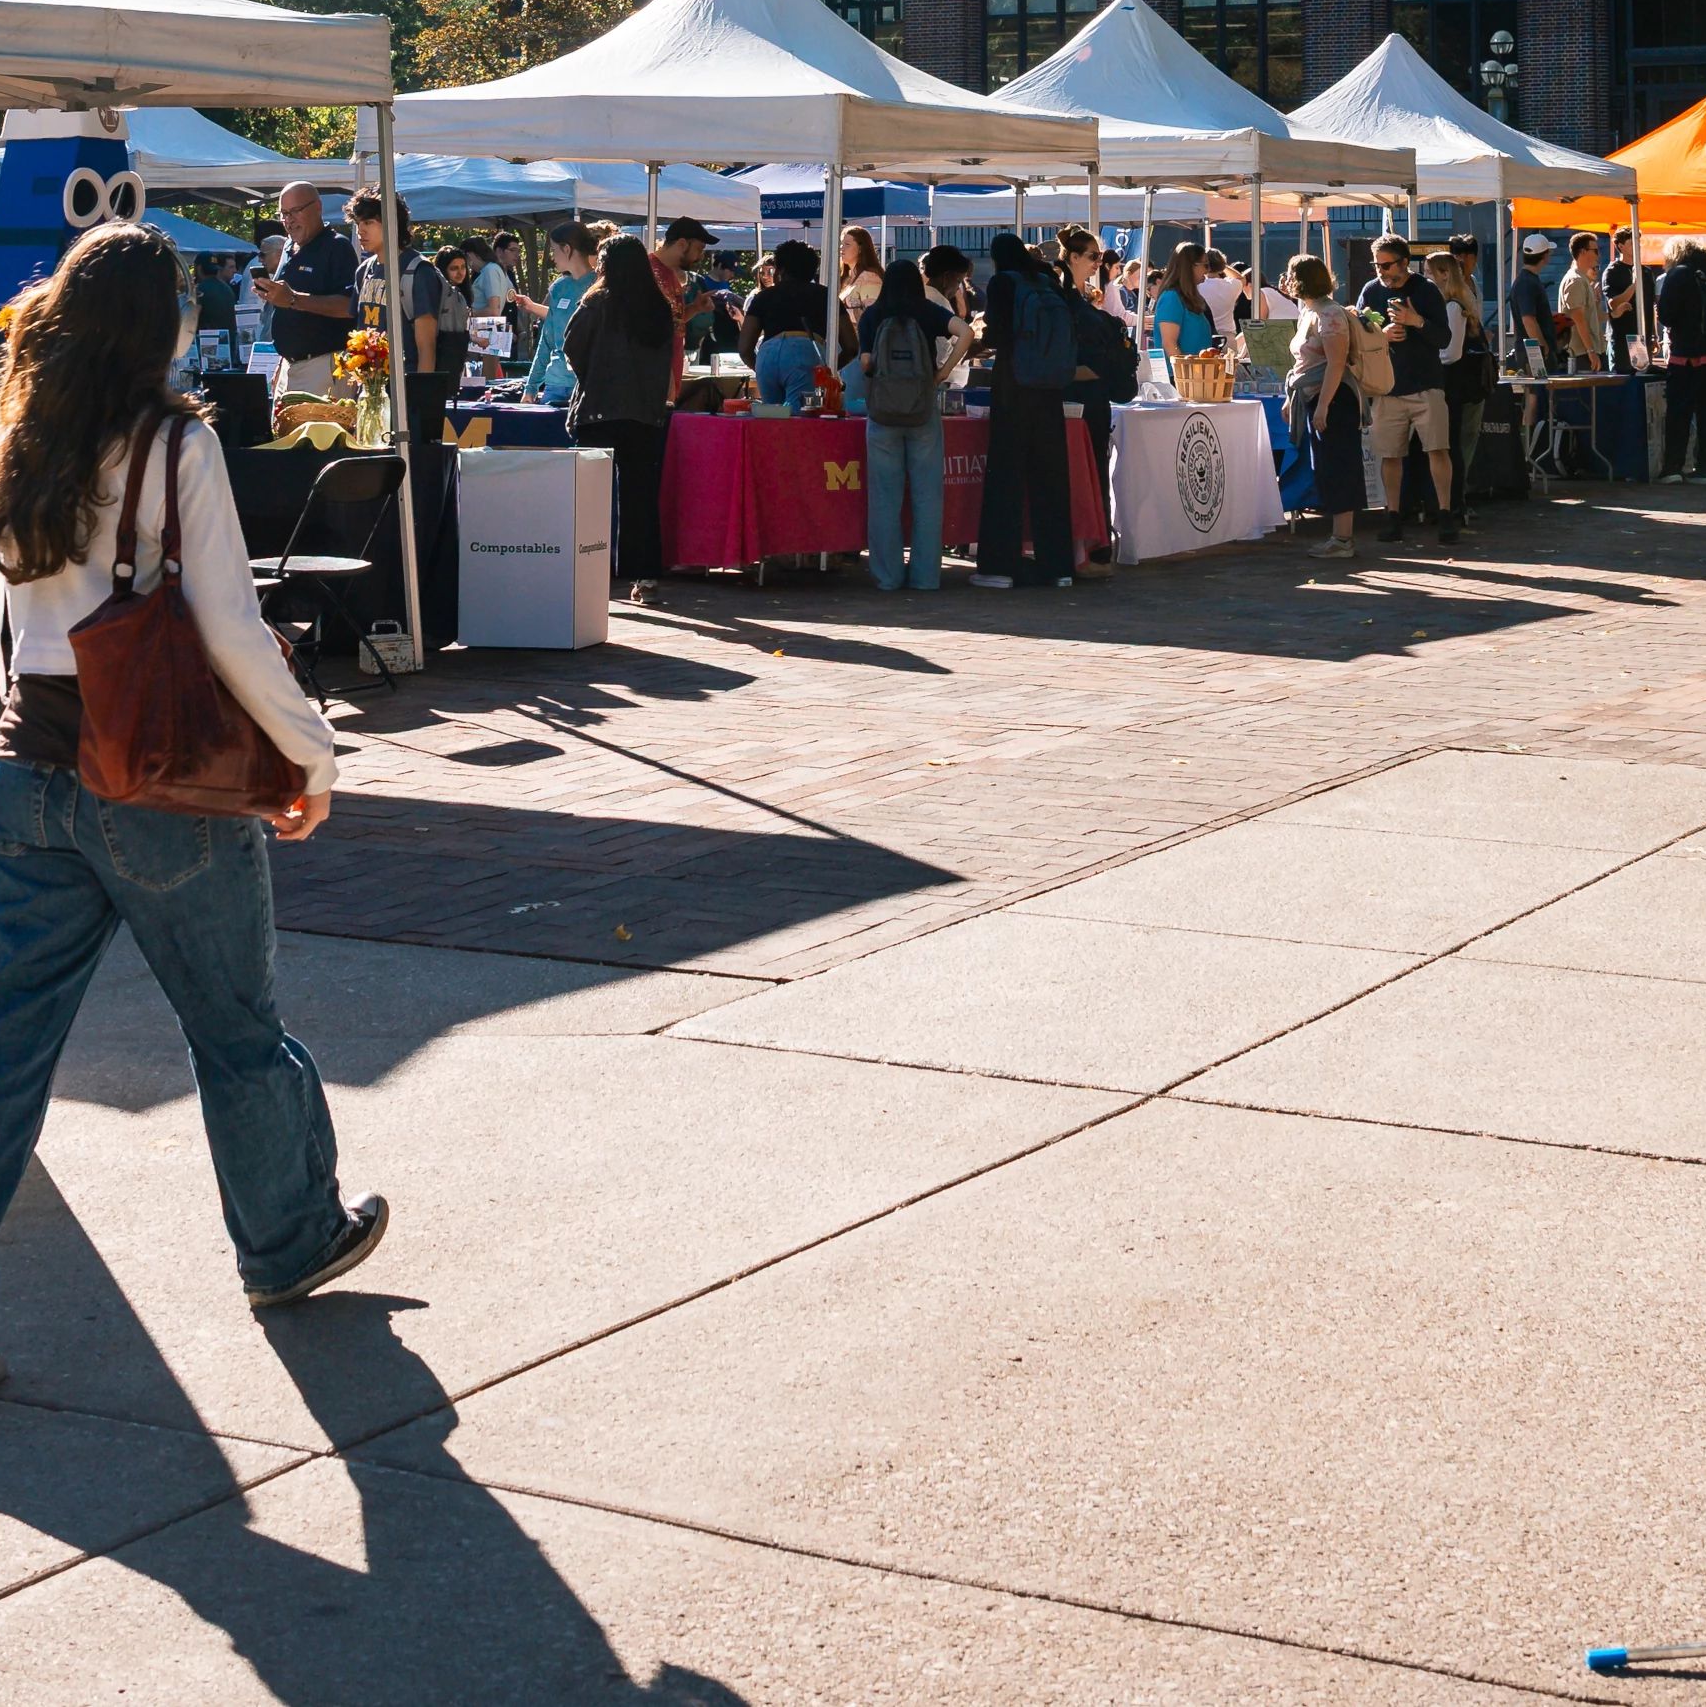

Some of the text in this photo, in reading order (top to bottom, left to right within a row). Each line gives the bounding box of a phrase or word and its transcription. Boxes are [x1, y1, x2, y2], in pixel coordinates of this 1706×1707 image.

[776, 199, 824, 209] SUSTAINABILI
[364, 305, 380, 326] M
[1180, 421, 1219, 464] RESILIENCY
[823, 460, 861, 491] M
[470, 542, 561, 555] Compostables
